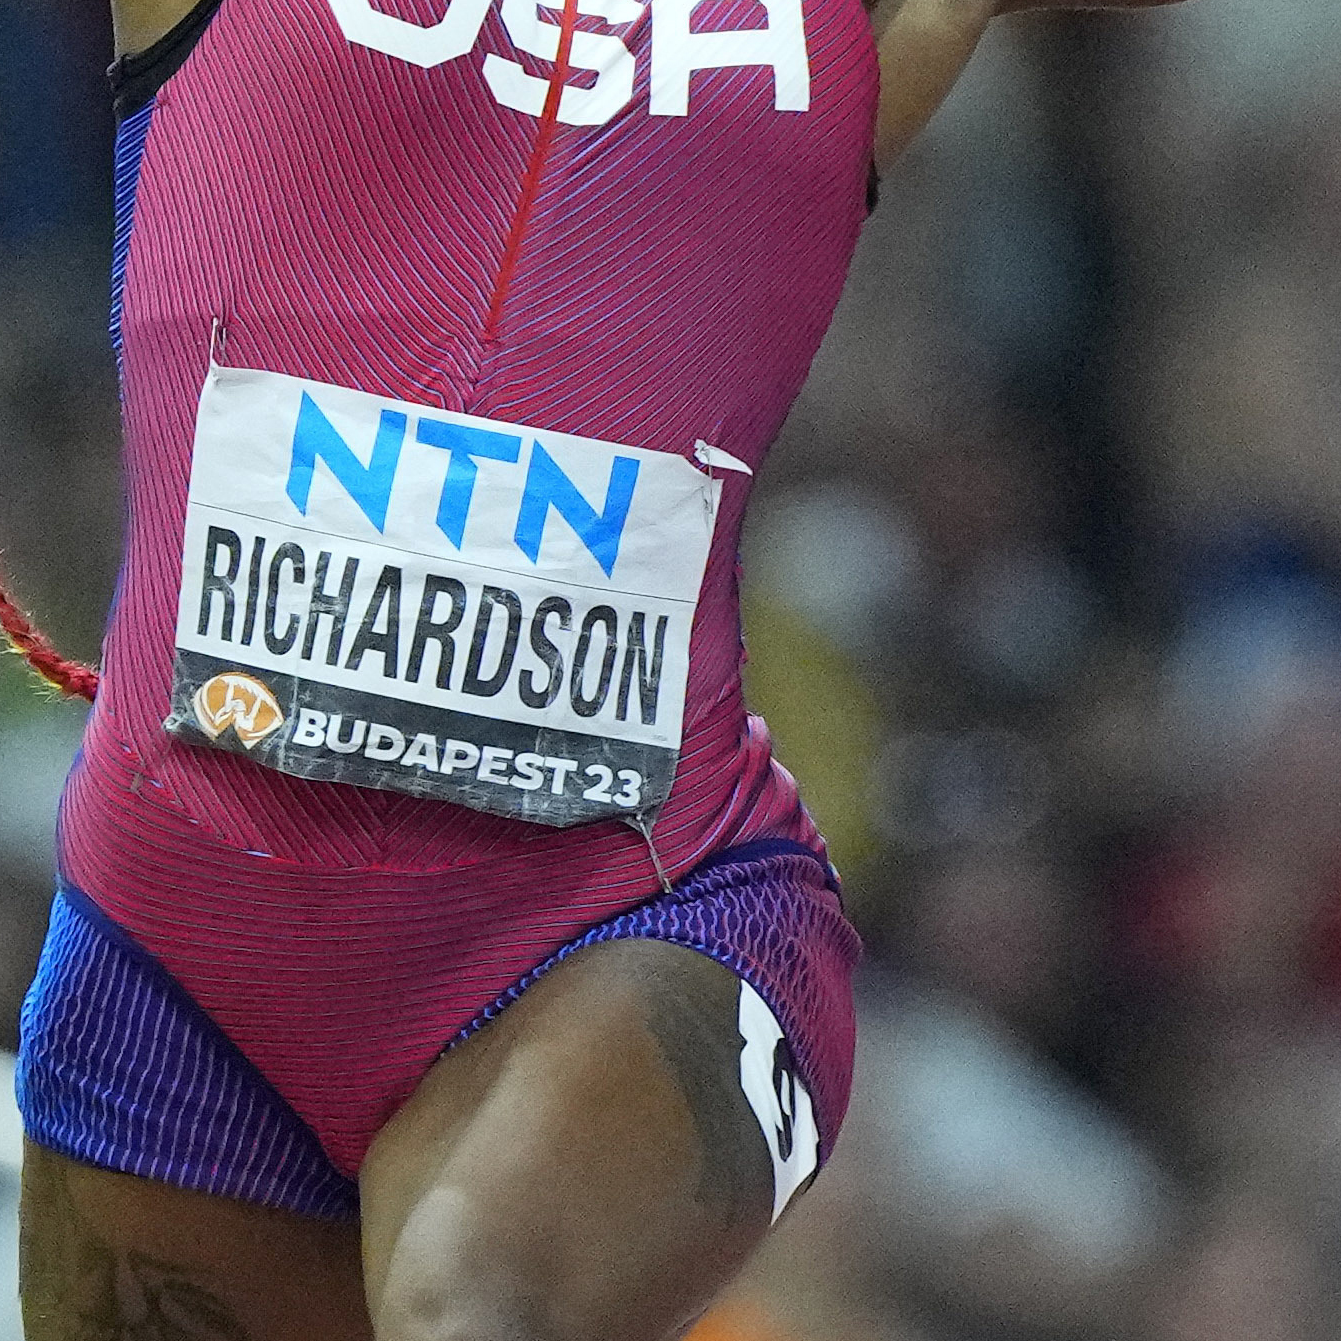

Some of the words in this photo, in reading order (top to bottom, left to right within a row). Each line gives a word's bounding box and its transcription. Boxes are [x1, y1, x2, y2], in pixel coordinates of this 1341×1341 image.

[285, 389, 641, 580] NTN
[196, 525, 669, 726] RICHARDSON
[291, 707, 579, 796] BUDAPEST
[582, 764, 643, 808] 23
